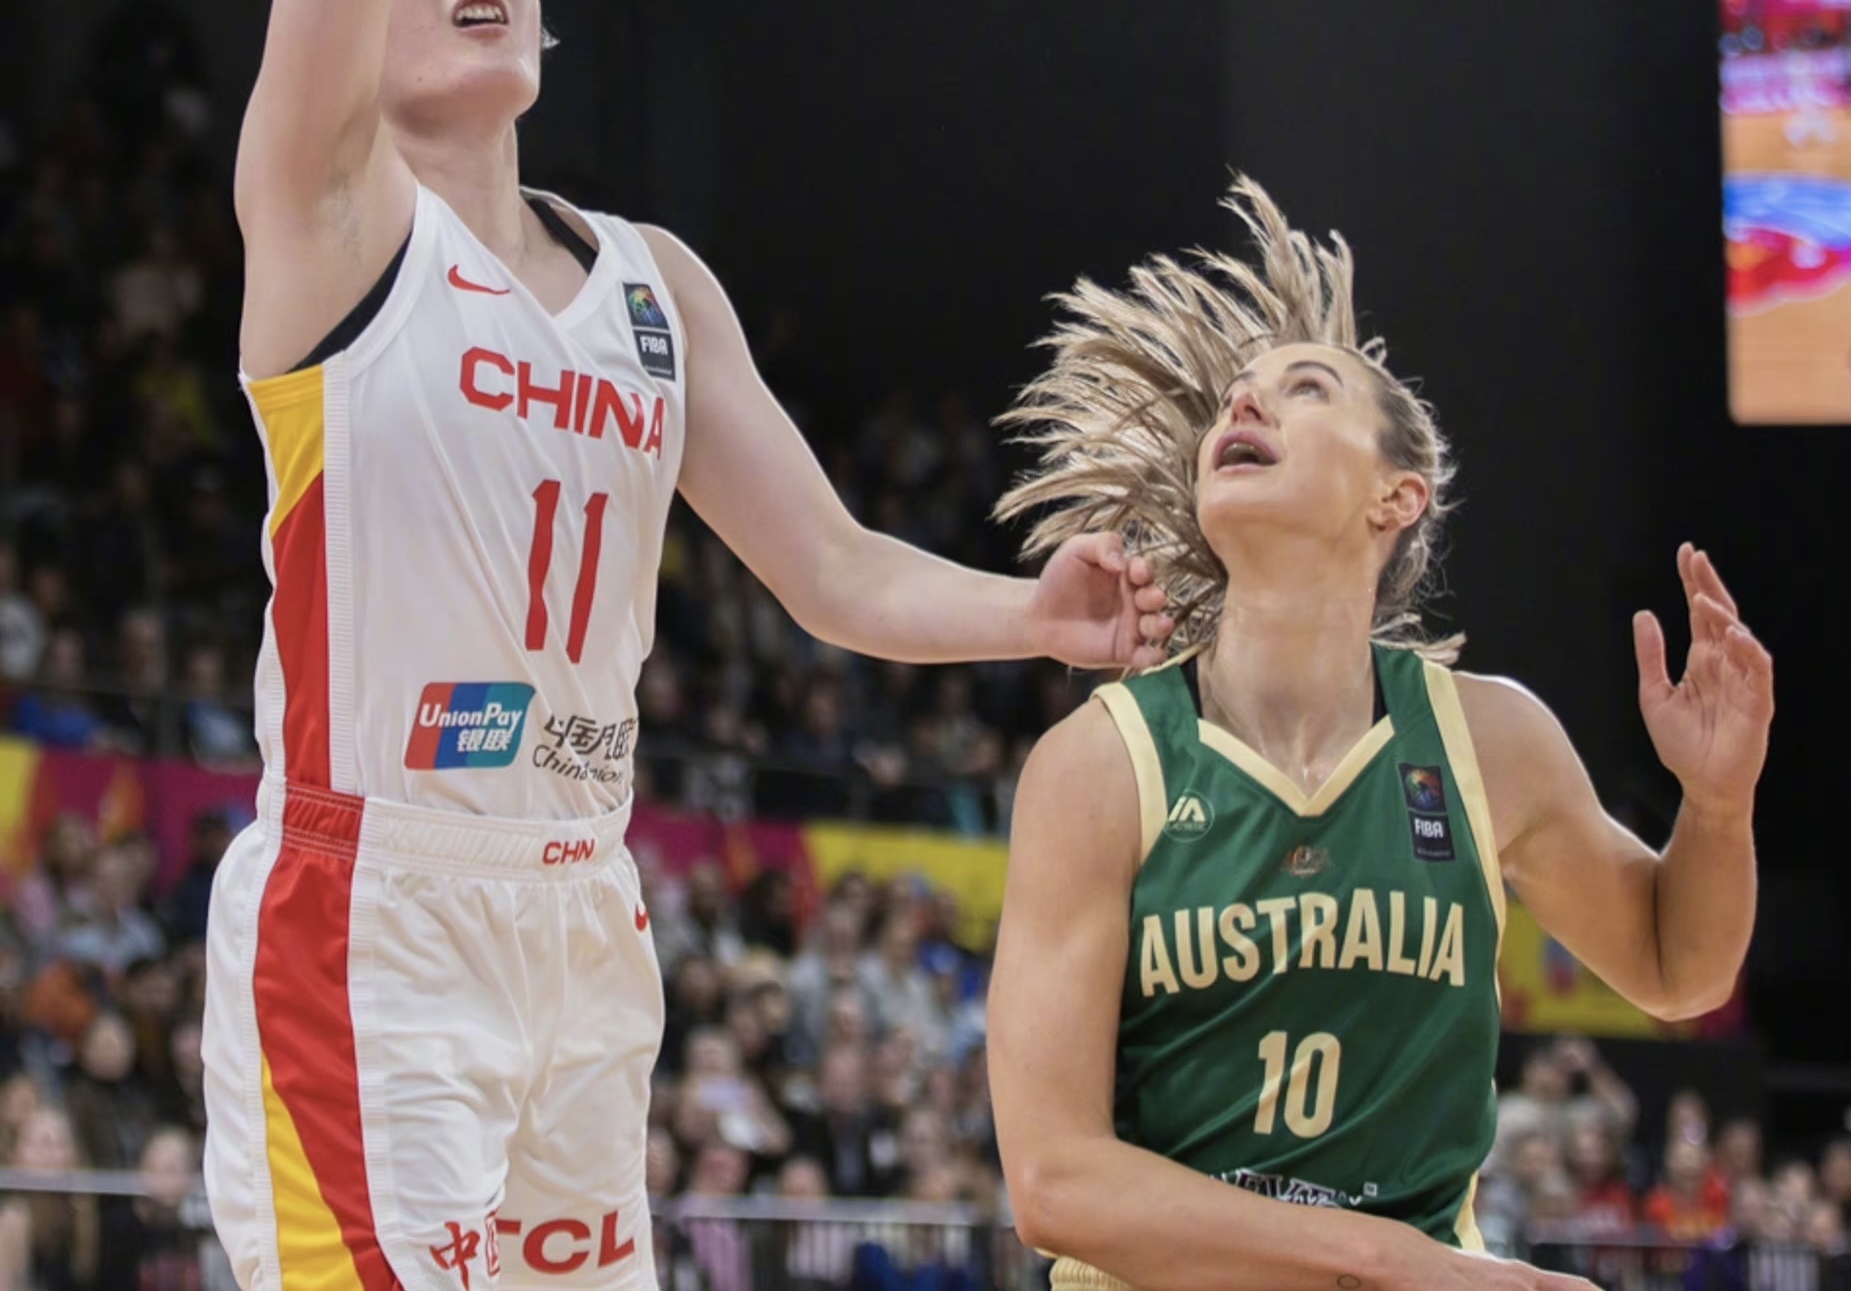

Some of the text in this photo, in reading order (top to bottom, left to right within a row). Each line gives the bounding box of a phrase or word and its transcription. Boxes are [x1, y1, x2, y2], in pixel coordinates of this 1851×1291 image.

[640, 336, 669, 356] FIBA
[459, 346, 665, 460] CHINA
[524, 479, 609, 664] 11
[419, 702, 523, 733] UnionPay
[457, 728, 512, 752] 银联
[1414, 817, 1444, 838] FIBA
[542, 839, 595, 865] CHN
[1140, 888, 1465, 998] AUSTRALIA
[1253, 1030, 1342, 1138] 10
